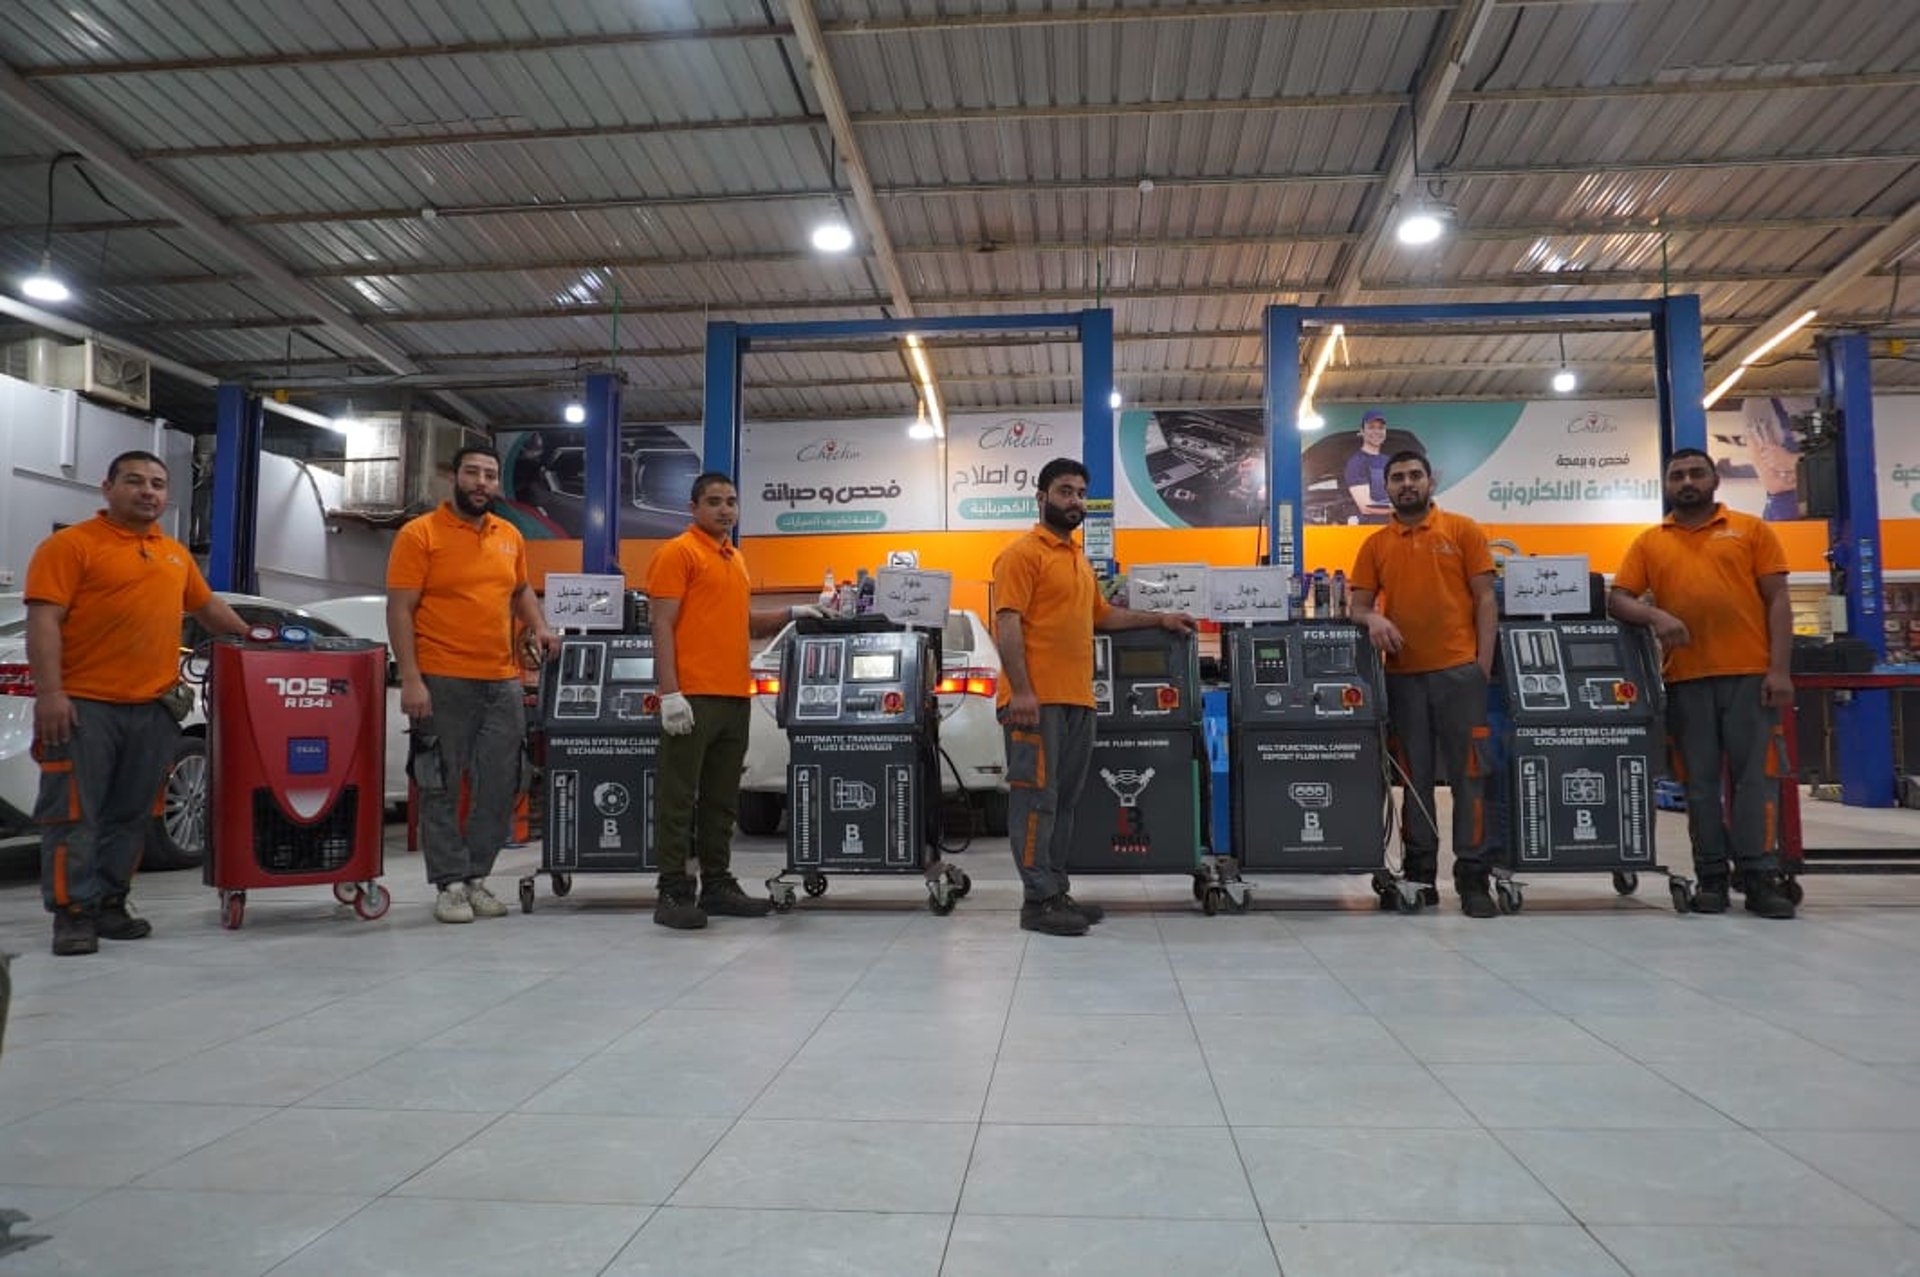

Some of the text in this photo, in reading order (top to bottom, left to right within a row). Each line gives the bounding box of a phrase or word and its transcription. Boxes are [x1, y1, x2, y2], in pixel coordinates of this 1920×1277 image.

[1598, 453, 1630, 468] فحص
[952, 464, 1009, 493] اصلاح
[761, 479, 902, 509] فحص و صيانة
[1516, 726, 1647, 737] COOLING SYSTEM CLEANING
[591, 738, 628, 746] SYSTEM
[794, 735, 845, 743] AUTOMATIC
[1586, 736, 1629, 745] MACHINE
[813, 743, 893, 752] FLUID EXCHANGER
